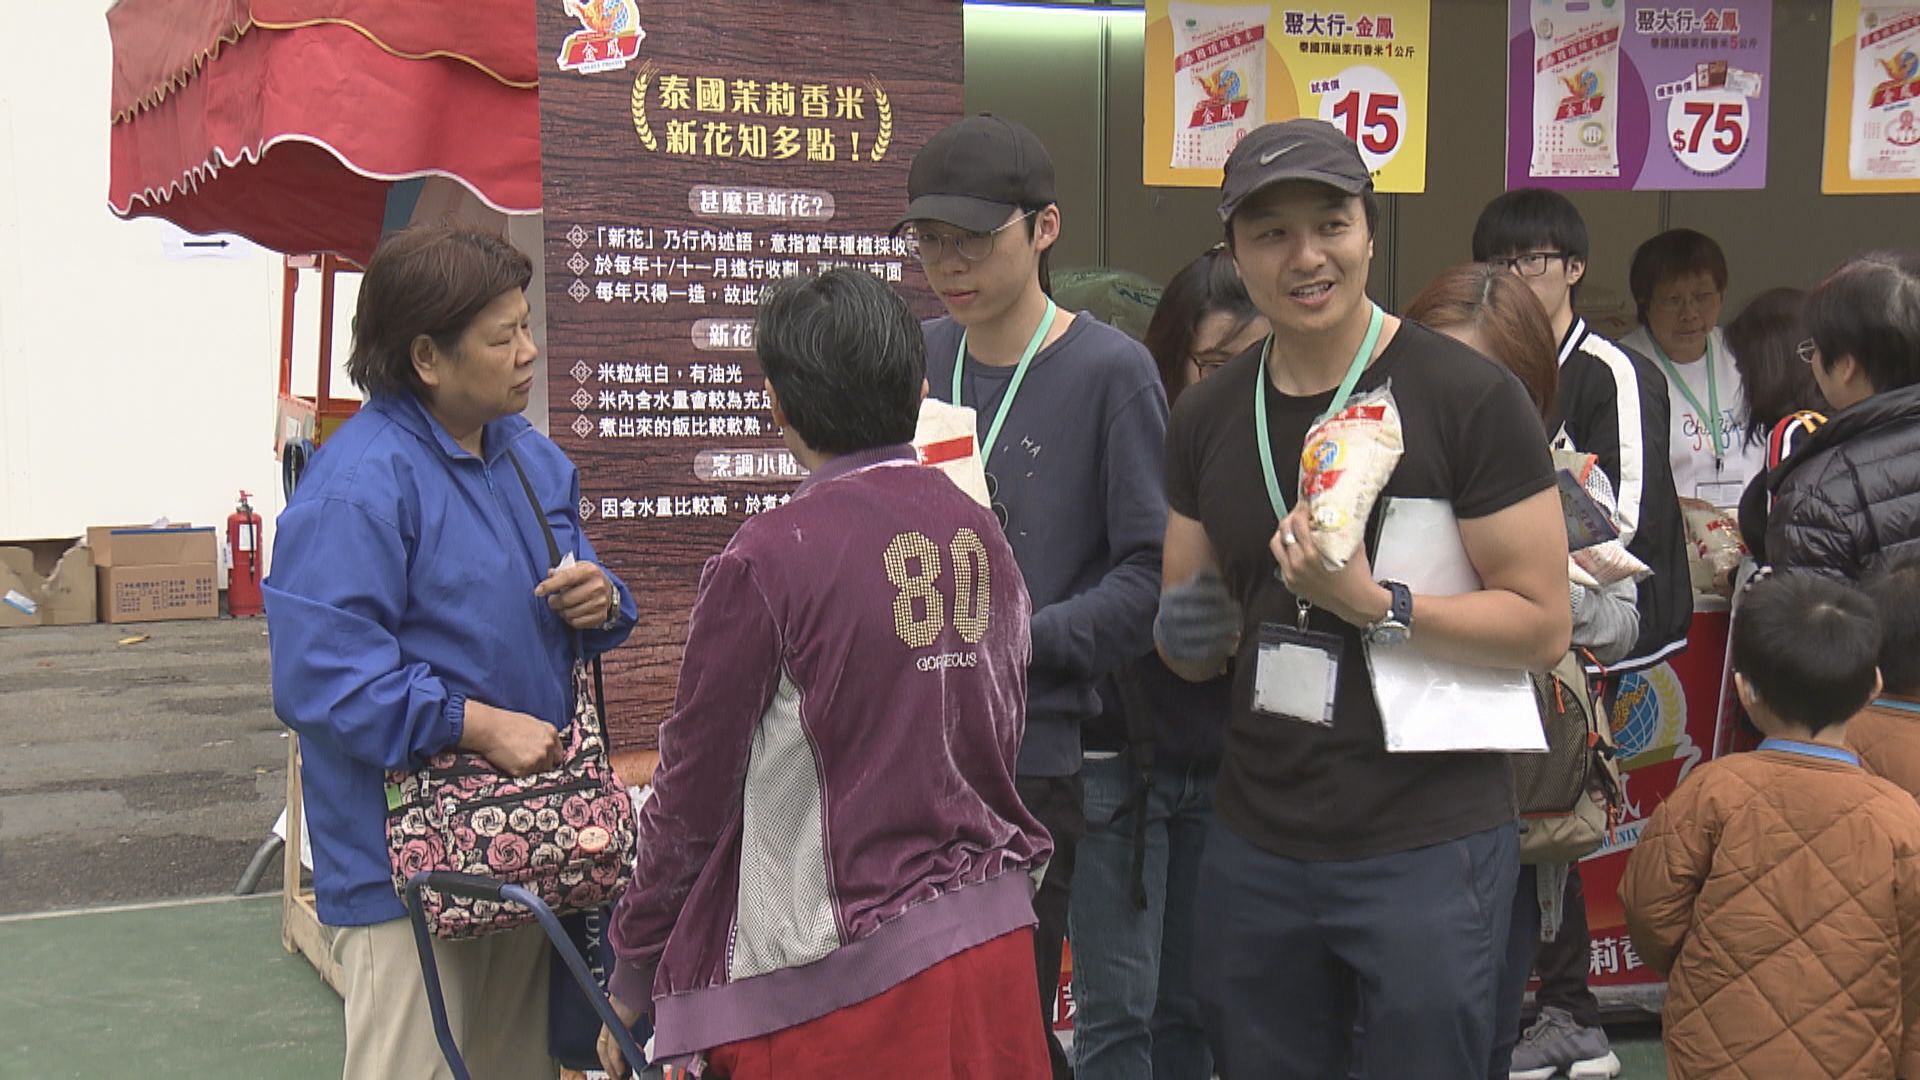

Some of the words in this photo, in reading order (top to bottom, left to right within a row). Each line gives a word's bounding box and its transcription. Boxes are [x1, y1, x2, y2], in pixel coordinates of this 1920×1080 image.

[1285, 11, 1394, 39] 聚大行-金鳳
[1637, 9, 1738, 33] 聚大行-金鳳
[658, 74, 865, 121] 泰國茉莉香米
[1333, 90, 1399, 155] 15
[1673, 102, 1743, 155] $75
[599, 415, 784, 438] 煮出來的飯比較軟熟，
[711, 453, 811, 478] 烹調小貼
[883, 527, 990, 649] 80
[916, 651, 978, 672] GOREOUS
